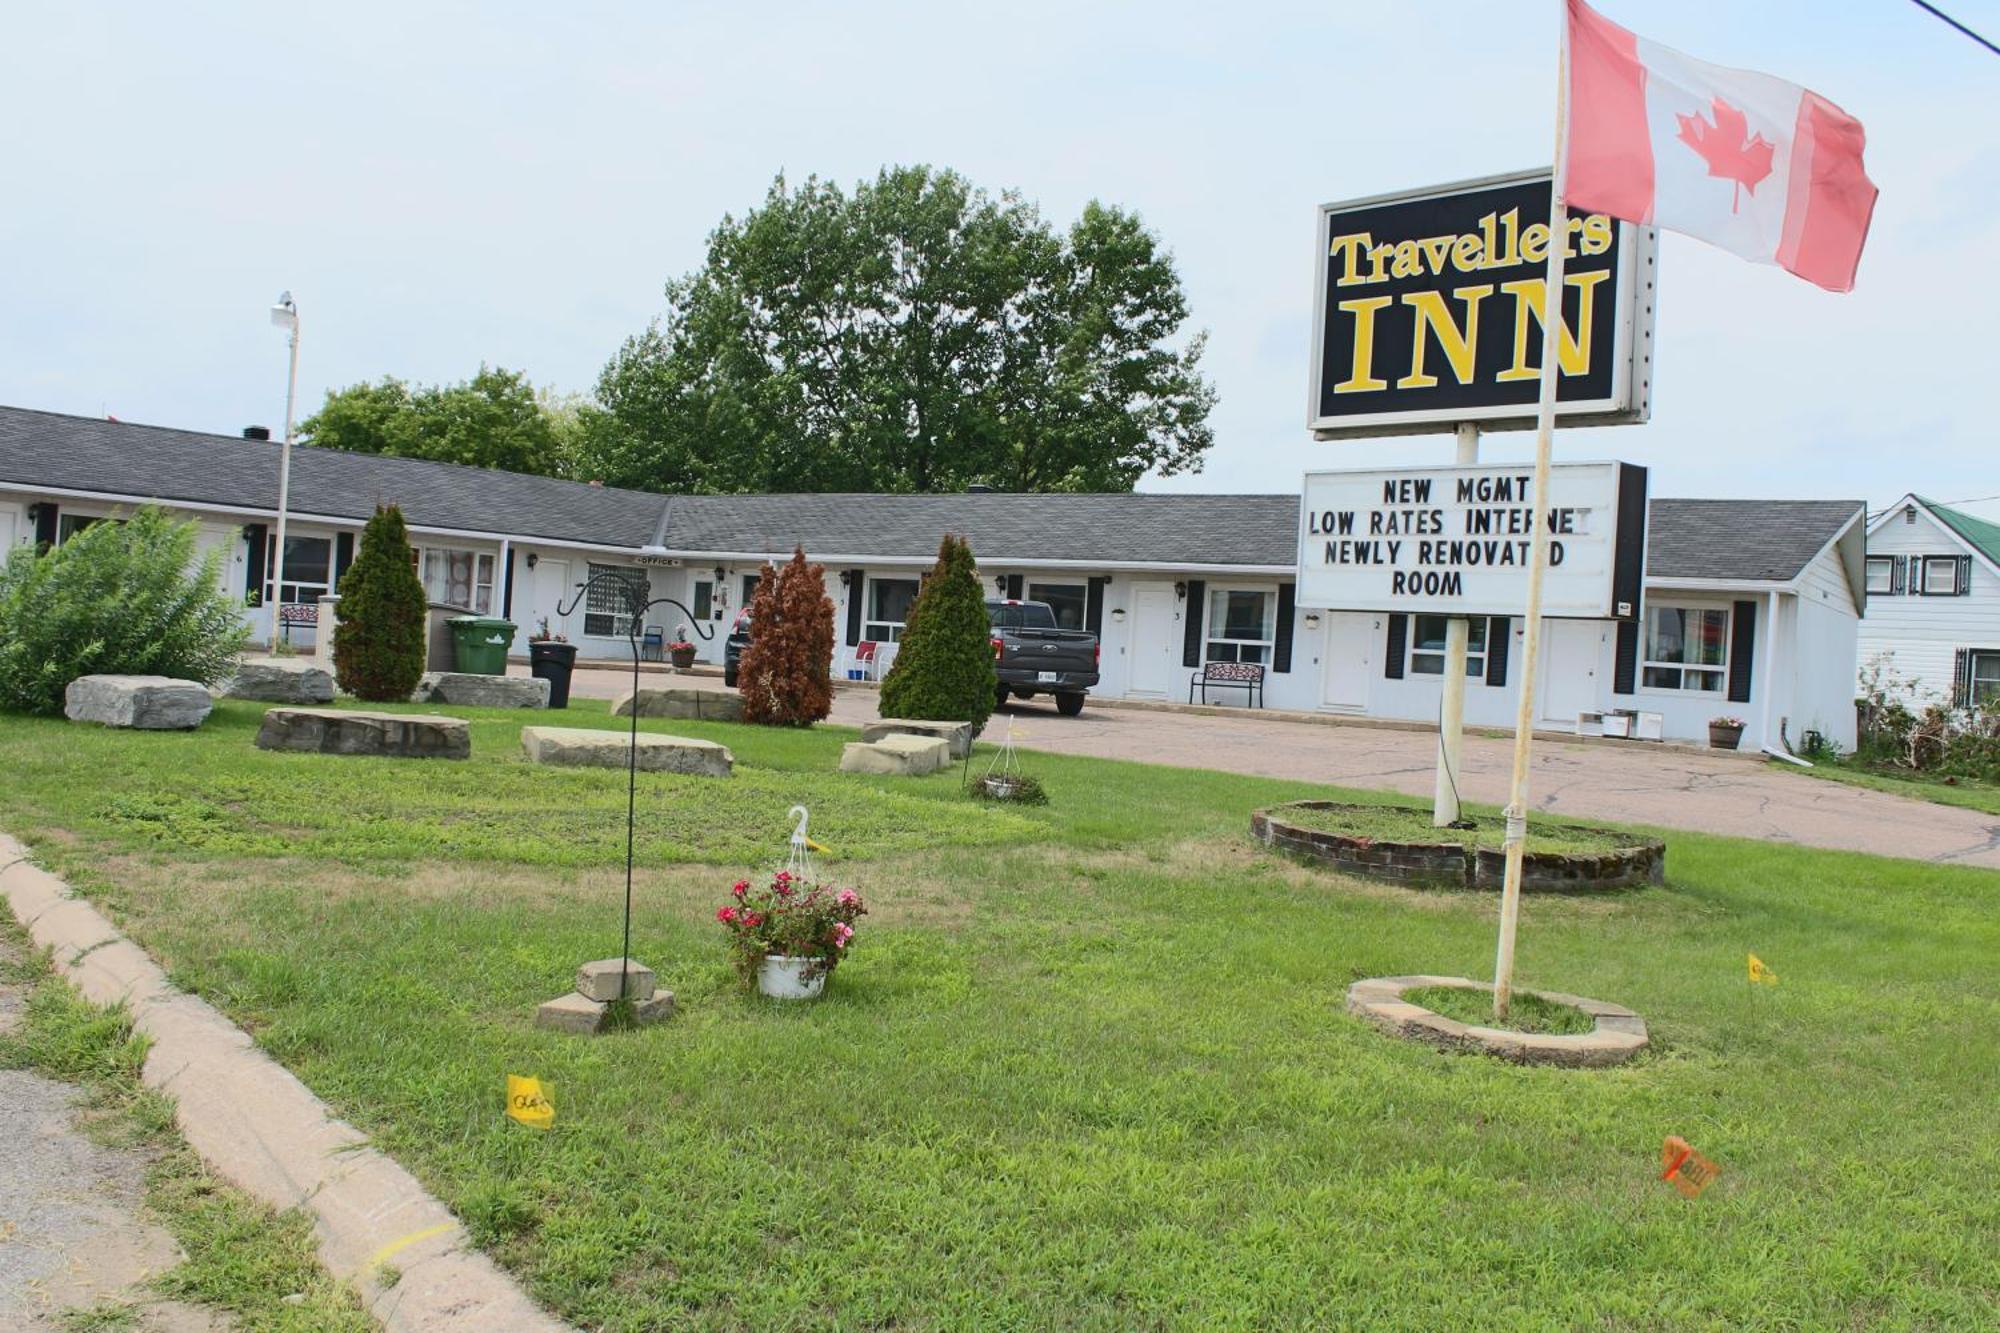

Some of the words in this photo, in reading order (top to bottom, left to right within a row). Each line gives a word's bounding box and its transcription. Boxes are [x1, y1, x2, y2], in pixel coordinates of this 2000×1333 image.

[1330, 206, 1613, 287] Travellers
[1333, 269, 1611, 394] INN
[1383, 478, 1432, 504] NEW
[1456, 476, 1531, 504] MGMT
[1309, 510, 1355, 535] LOW
[1369, 509, 1444, 535] RATES
[642, 557, 673, 566] OFFICE
[1324, 540, 1402, 565] NEWLY
[1418, 540, 1565, 567] RENOVATD
[1391, 571, 1463, 596] ROOM
[1374, 620, 1381, 630] 2
